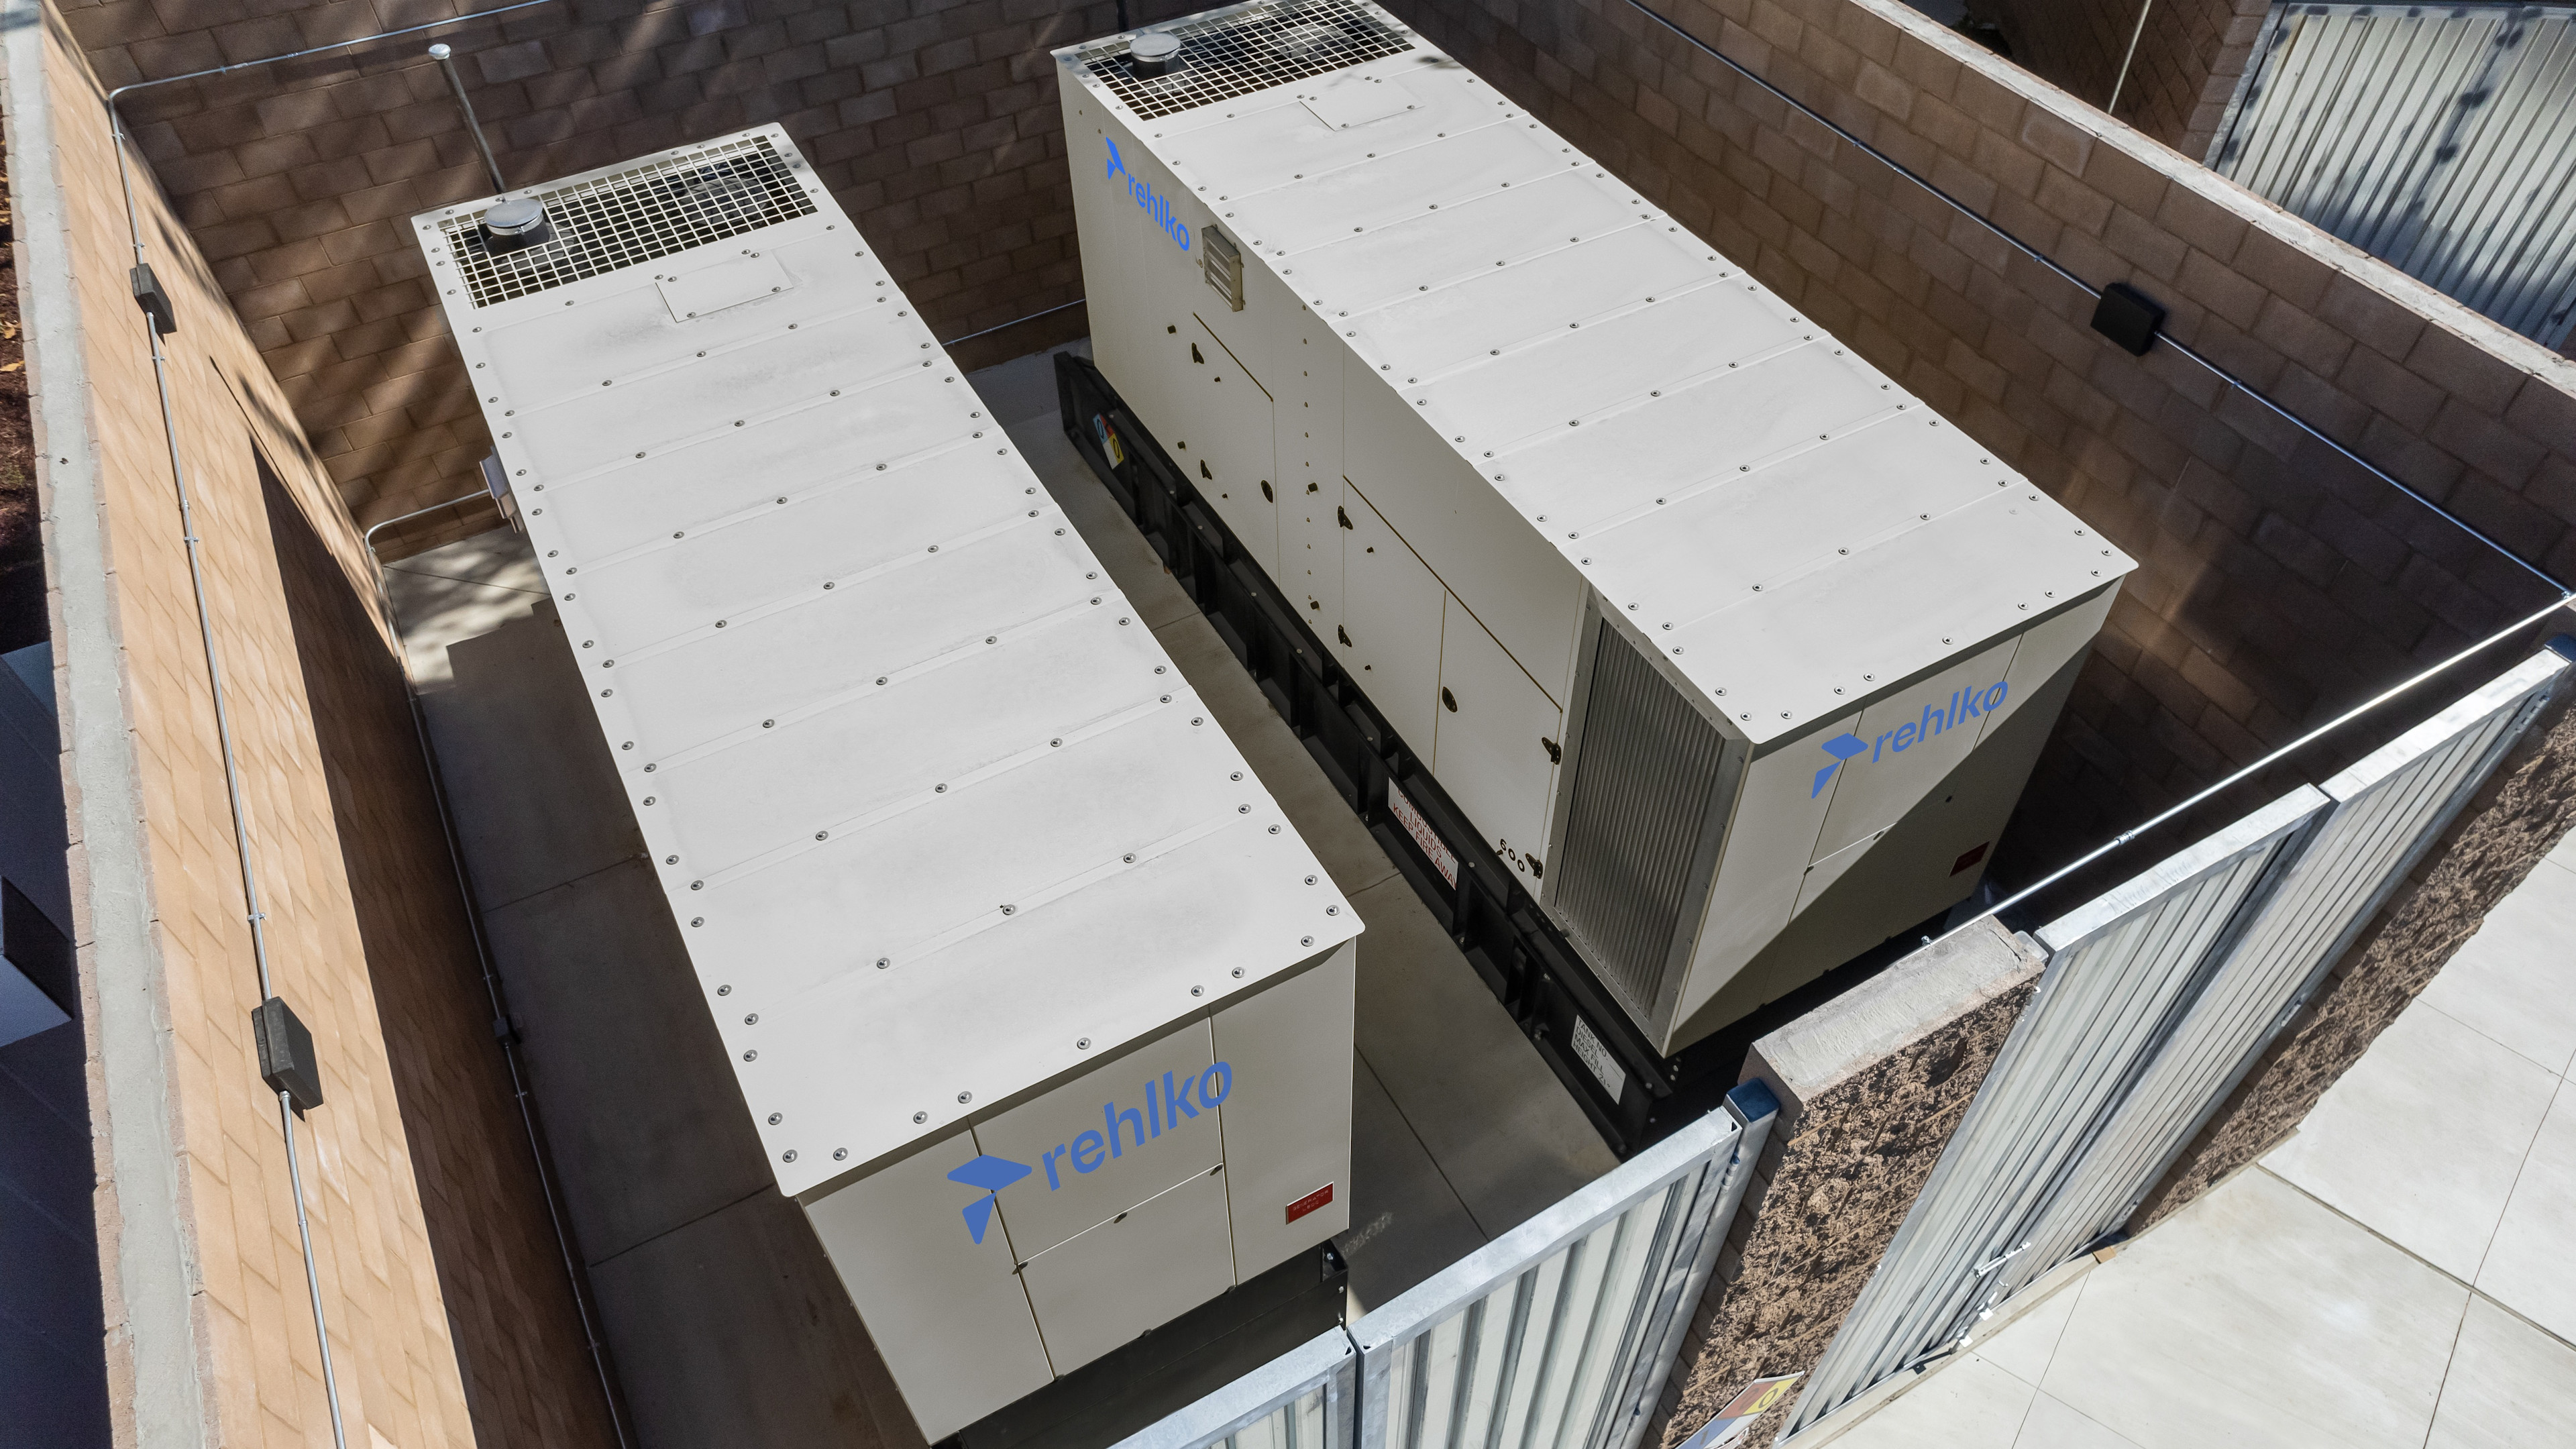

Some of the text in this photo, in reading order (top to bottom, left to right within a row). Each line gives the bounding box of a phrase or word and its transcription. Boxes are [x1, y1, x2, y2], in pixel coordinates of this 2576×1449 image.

[1128, 173, 1191, 252] rehlko
[1872, 681, 2008, 763] rehlko
[1393, 802, 1413, 831] KEEP
[1415, 831, 1433, 860] FIRE
[1410, 812, 1442, 858] LIQUIDS
[1500, 839, 1525, 872] 600
[1573, 1040, 1597, 1072] HEIGHT
[1575, 1034, 1604, 1075] MAX FILL
[1576, 1026, 1599, 1059] DIESEL
[1578, 1017, 1608, 1061] TANK NO.
[1042, 1061, 1232, 1191] rehlko
[1758, 1388, 1778, 1408] 0
